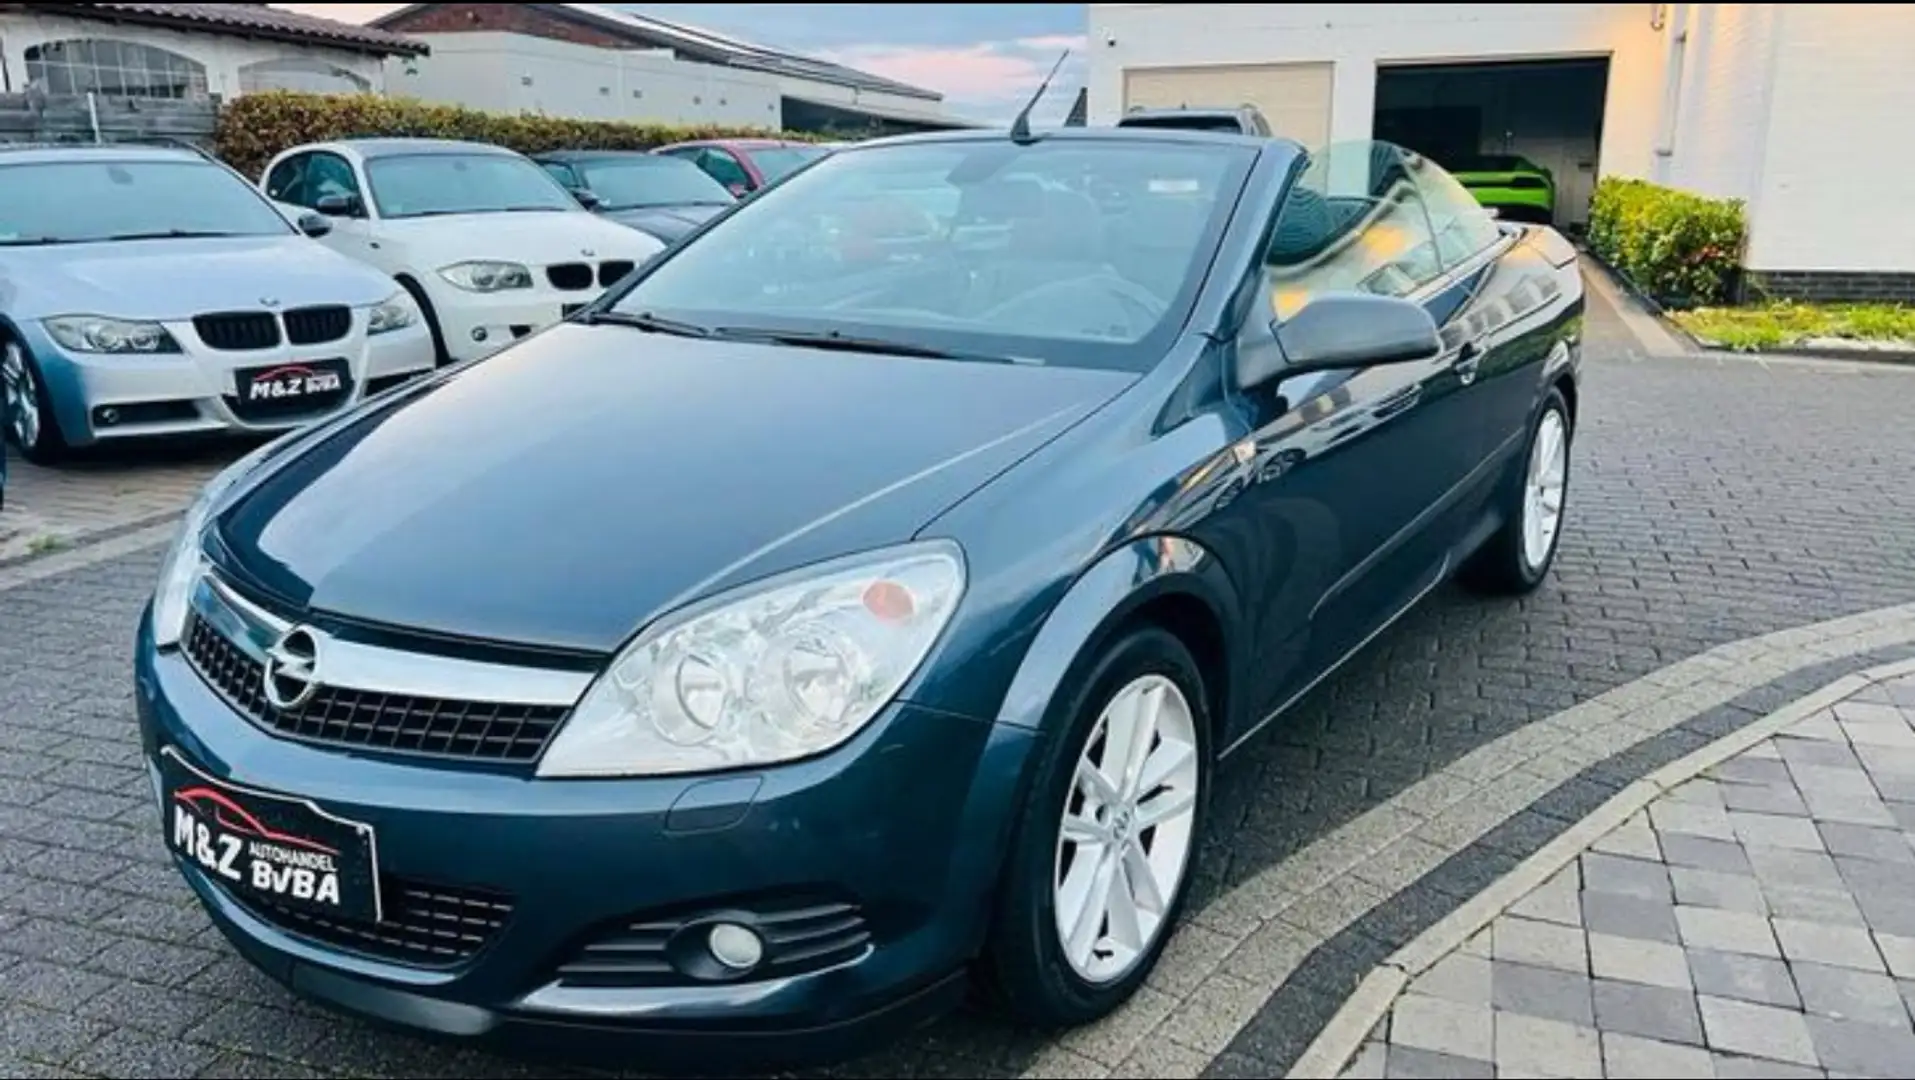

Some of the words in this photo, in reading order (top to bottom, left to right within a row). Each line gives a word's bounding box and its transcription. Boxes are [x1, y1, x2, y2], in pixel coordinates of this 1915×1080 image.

[250, 379, 302, 400] M&Z
[174, 804, 242, 881] M&Z
[249, 841, 338, 872] AUTOHANDEL
